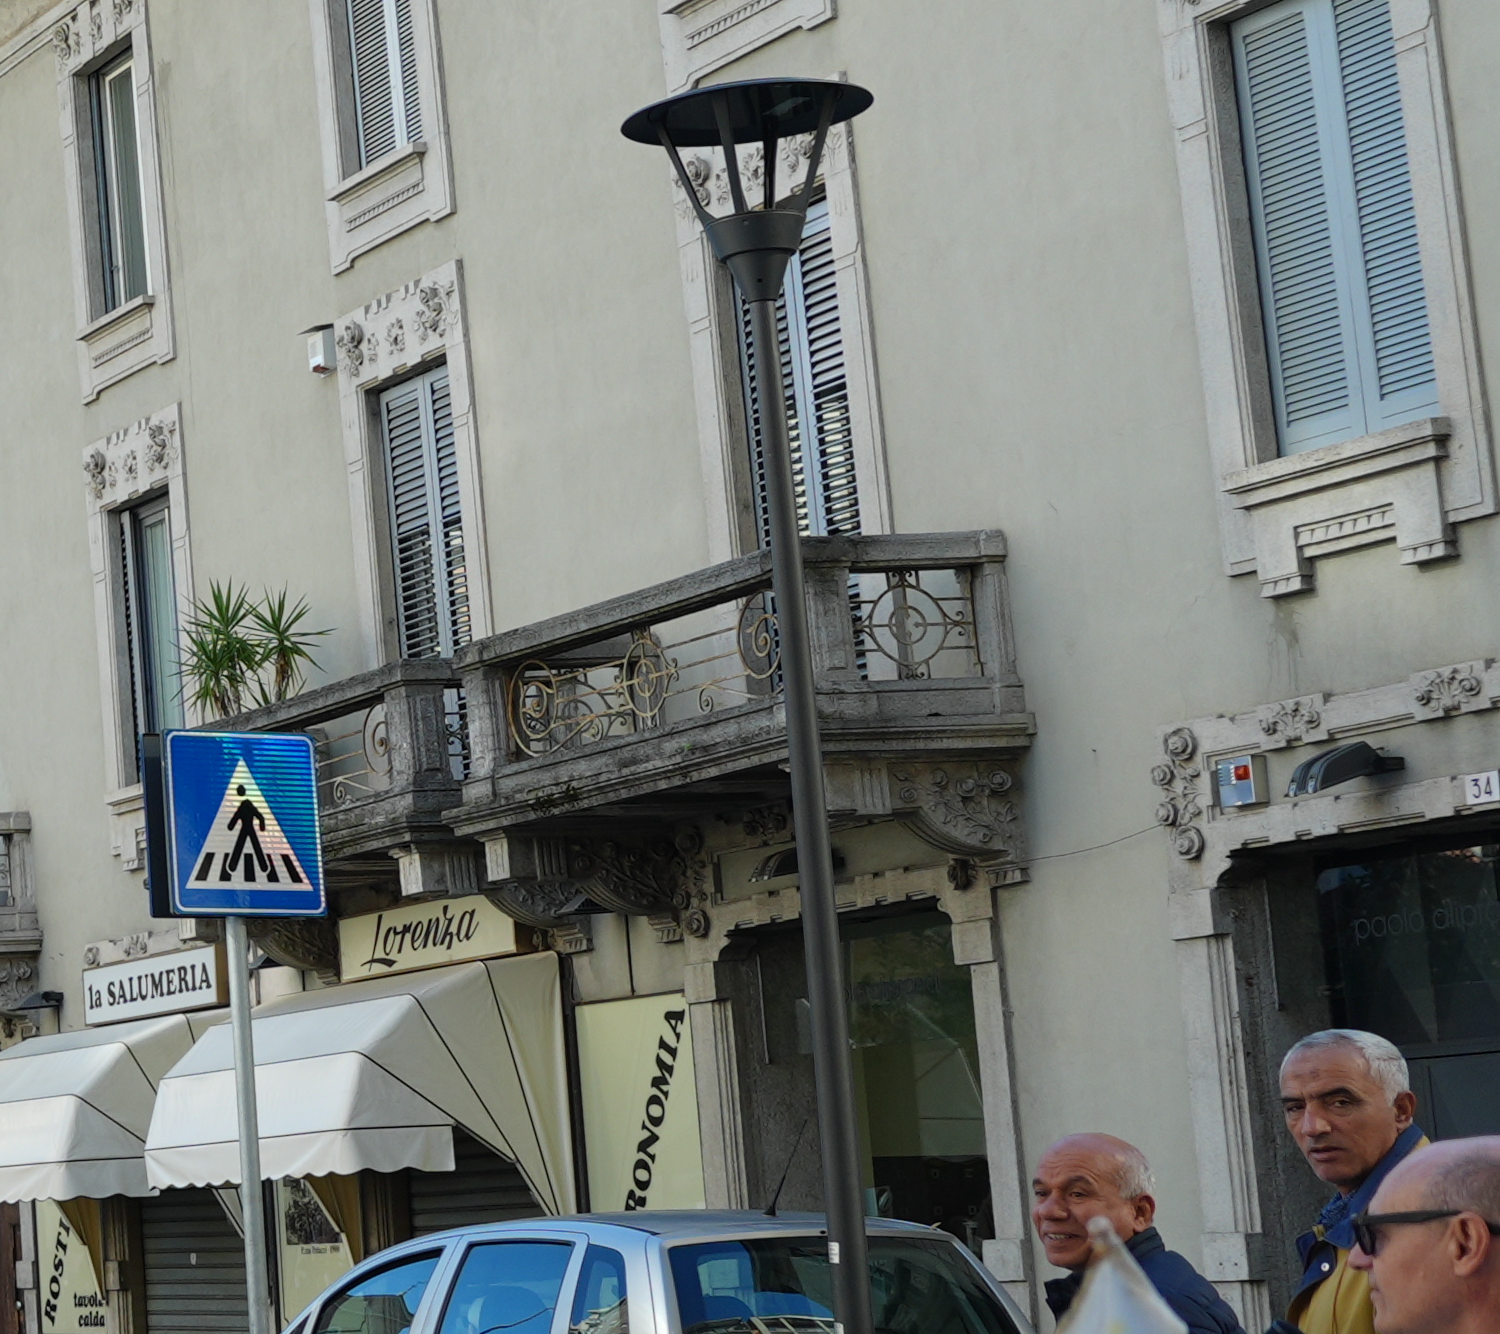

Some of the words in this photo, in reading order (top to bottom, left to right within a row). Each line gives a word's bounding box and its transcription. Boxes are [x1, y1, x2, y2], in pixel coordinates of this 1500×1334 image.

[1471, 776, 1493, 798] 34
[87, 981, 103, 1010] la
[106, 962, 212, 1006] SALUMERIA
[78, 1310, 106, 1328] calda
